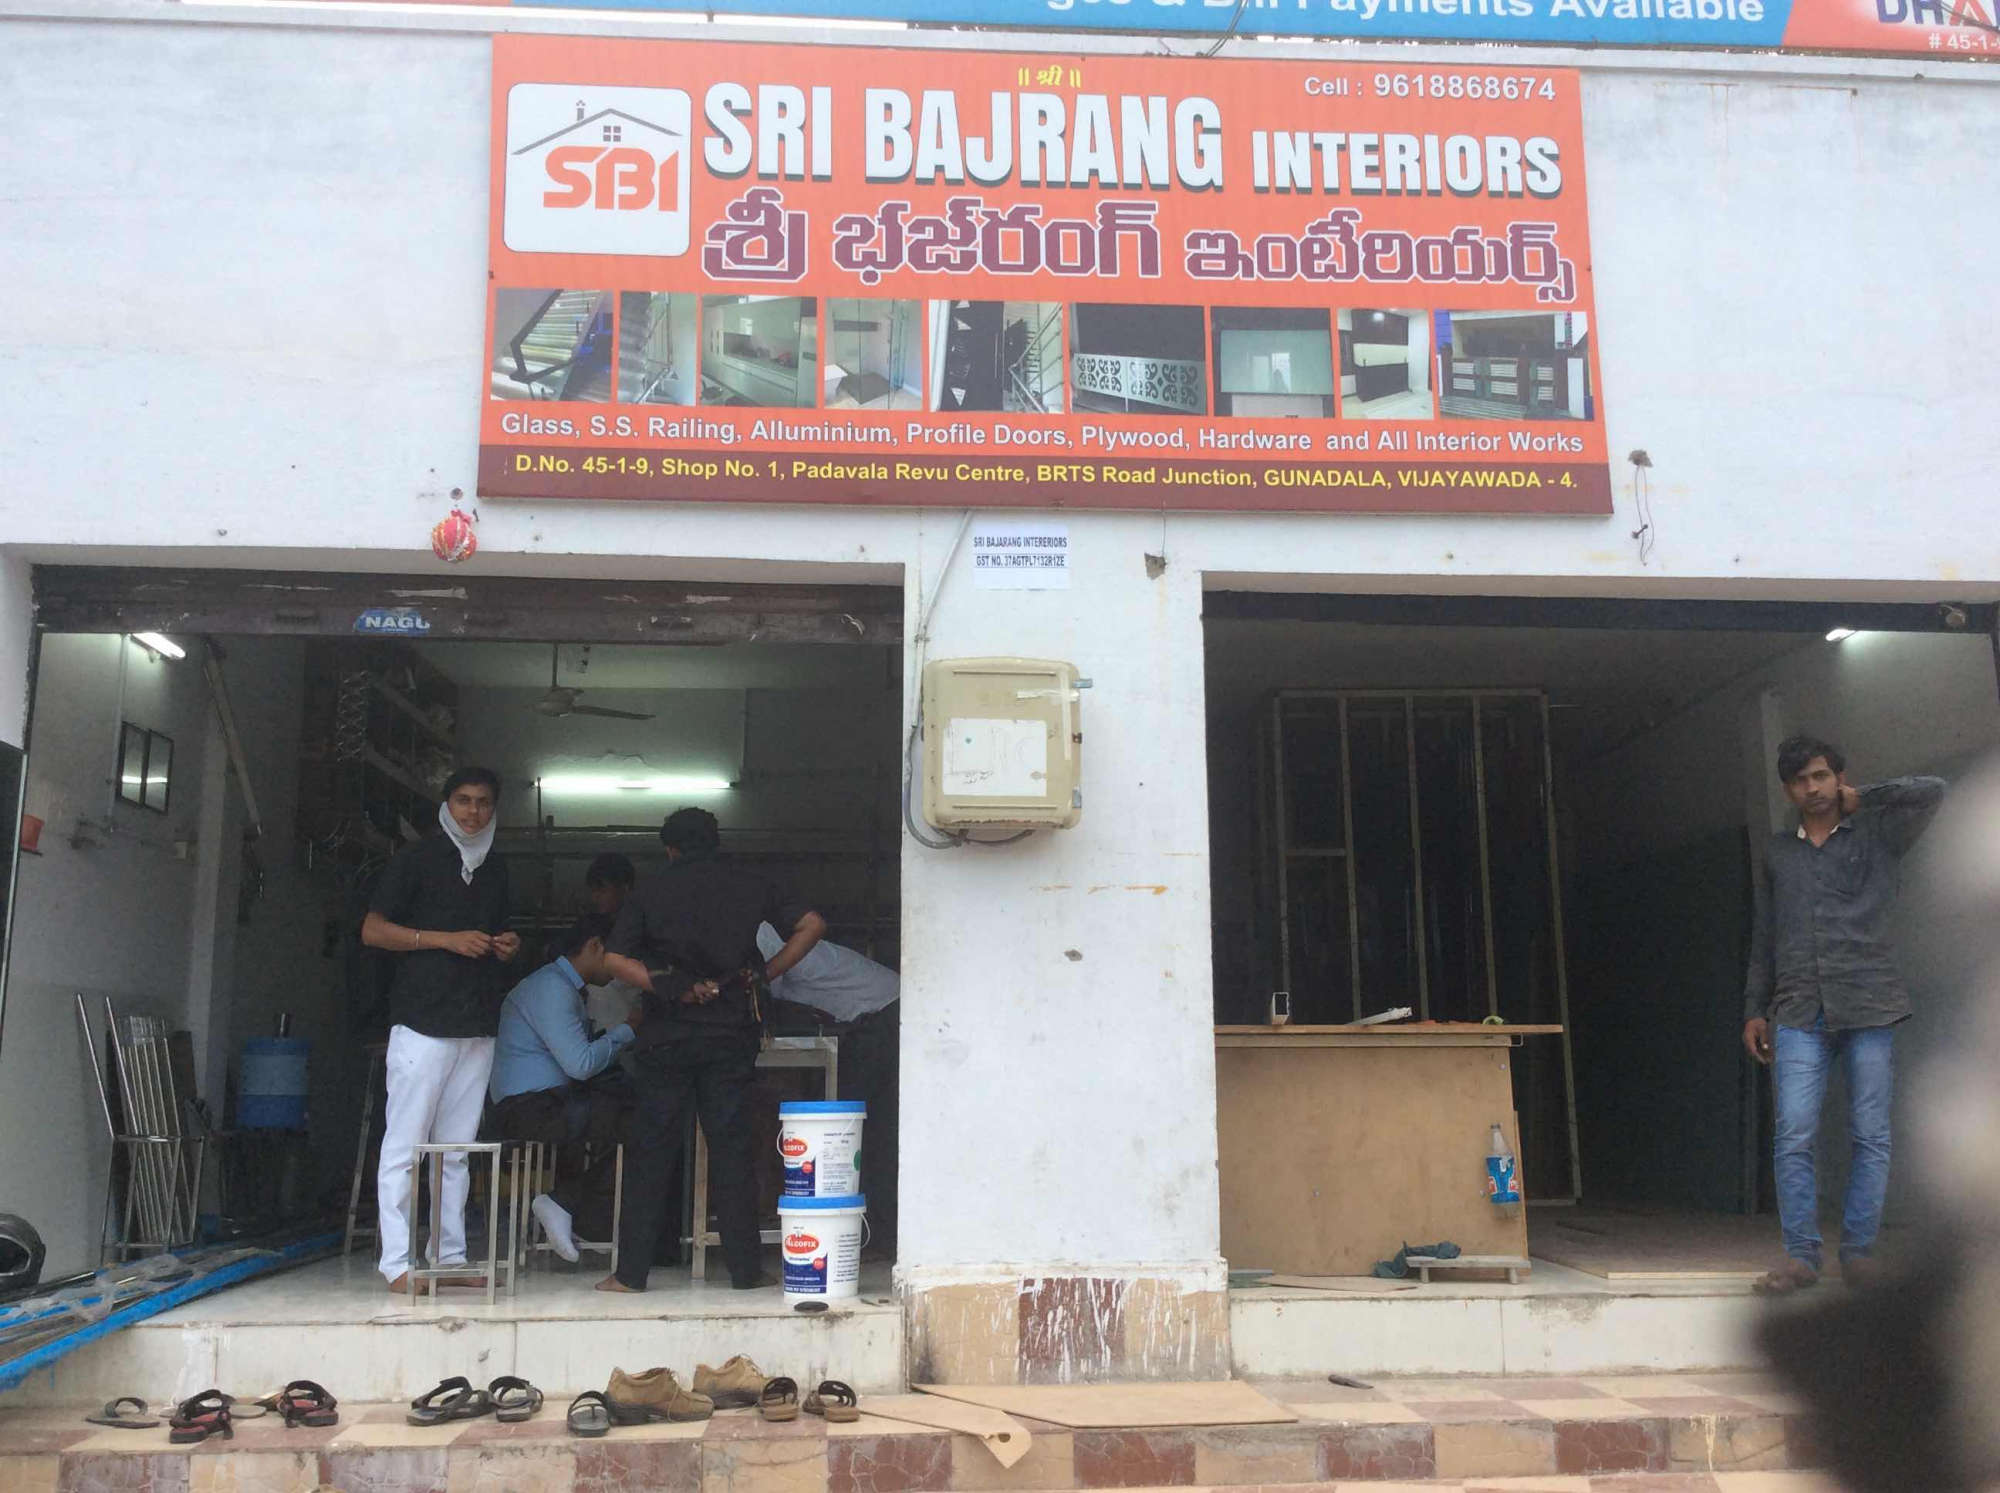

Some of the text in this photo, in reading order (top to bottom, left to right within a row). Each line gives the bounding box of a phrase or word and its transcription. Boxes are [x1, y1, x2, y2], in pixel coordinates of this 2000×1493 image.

[1304, 77, 1348, 96] Cell
[1374, 73, 1556, 100] 9618868674
[704, 82, 1563, 199] SRI BAJRANG INTERIORS
[701, 186, 808, 283] శ్రీ
[501, 413, 1583, 452] Glass, S.S. Railing, Alluminium, Profile Doors, Plywood, Hardware and All Interior Works
[516, 455, 575, 473] D.No.
[582, 457, 654, 477] 45-1-9,
[662, 458, 718, 479] Shop
[725, 460, 760, 477] No.
[768, 461, 785, 480] 1,
[793, 461, 888, 480] Padavala
[896, 464, 948, 481] Revu
[955, 464, 1031, 483] Centre,
[1037, 465, 1096, 482] BRTS
[1103, 466, 1156, 483] Road
[1162, 468, 1257, 488] Junction,
[1264, 469, 1392, 490] GUNADALA,
[1398, 470, 1541, 488] VIJAYAWADA
[1560, 472, 1578, 488] 4.
[974, 536, 985, 548] SRI
[986, 536, 1022, 548] BAJARANG
[976, 555, 989, 567] GST
